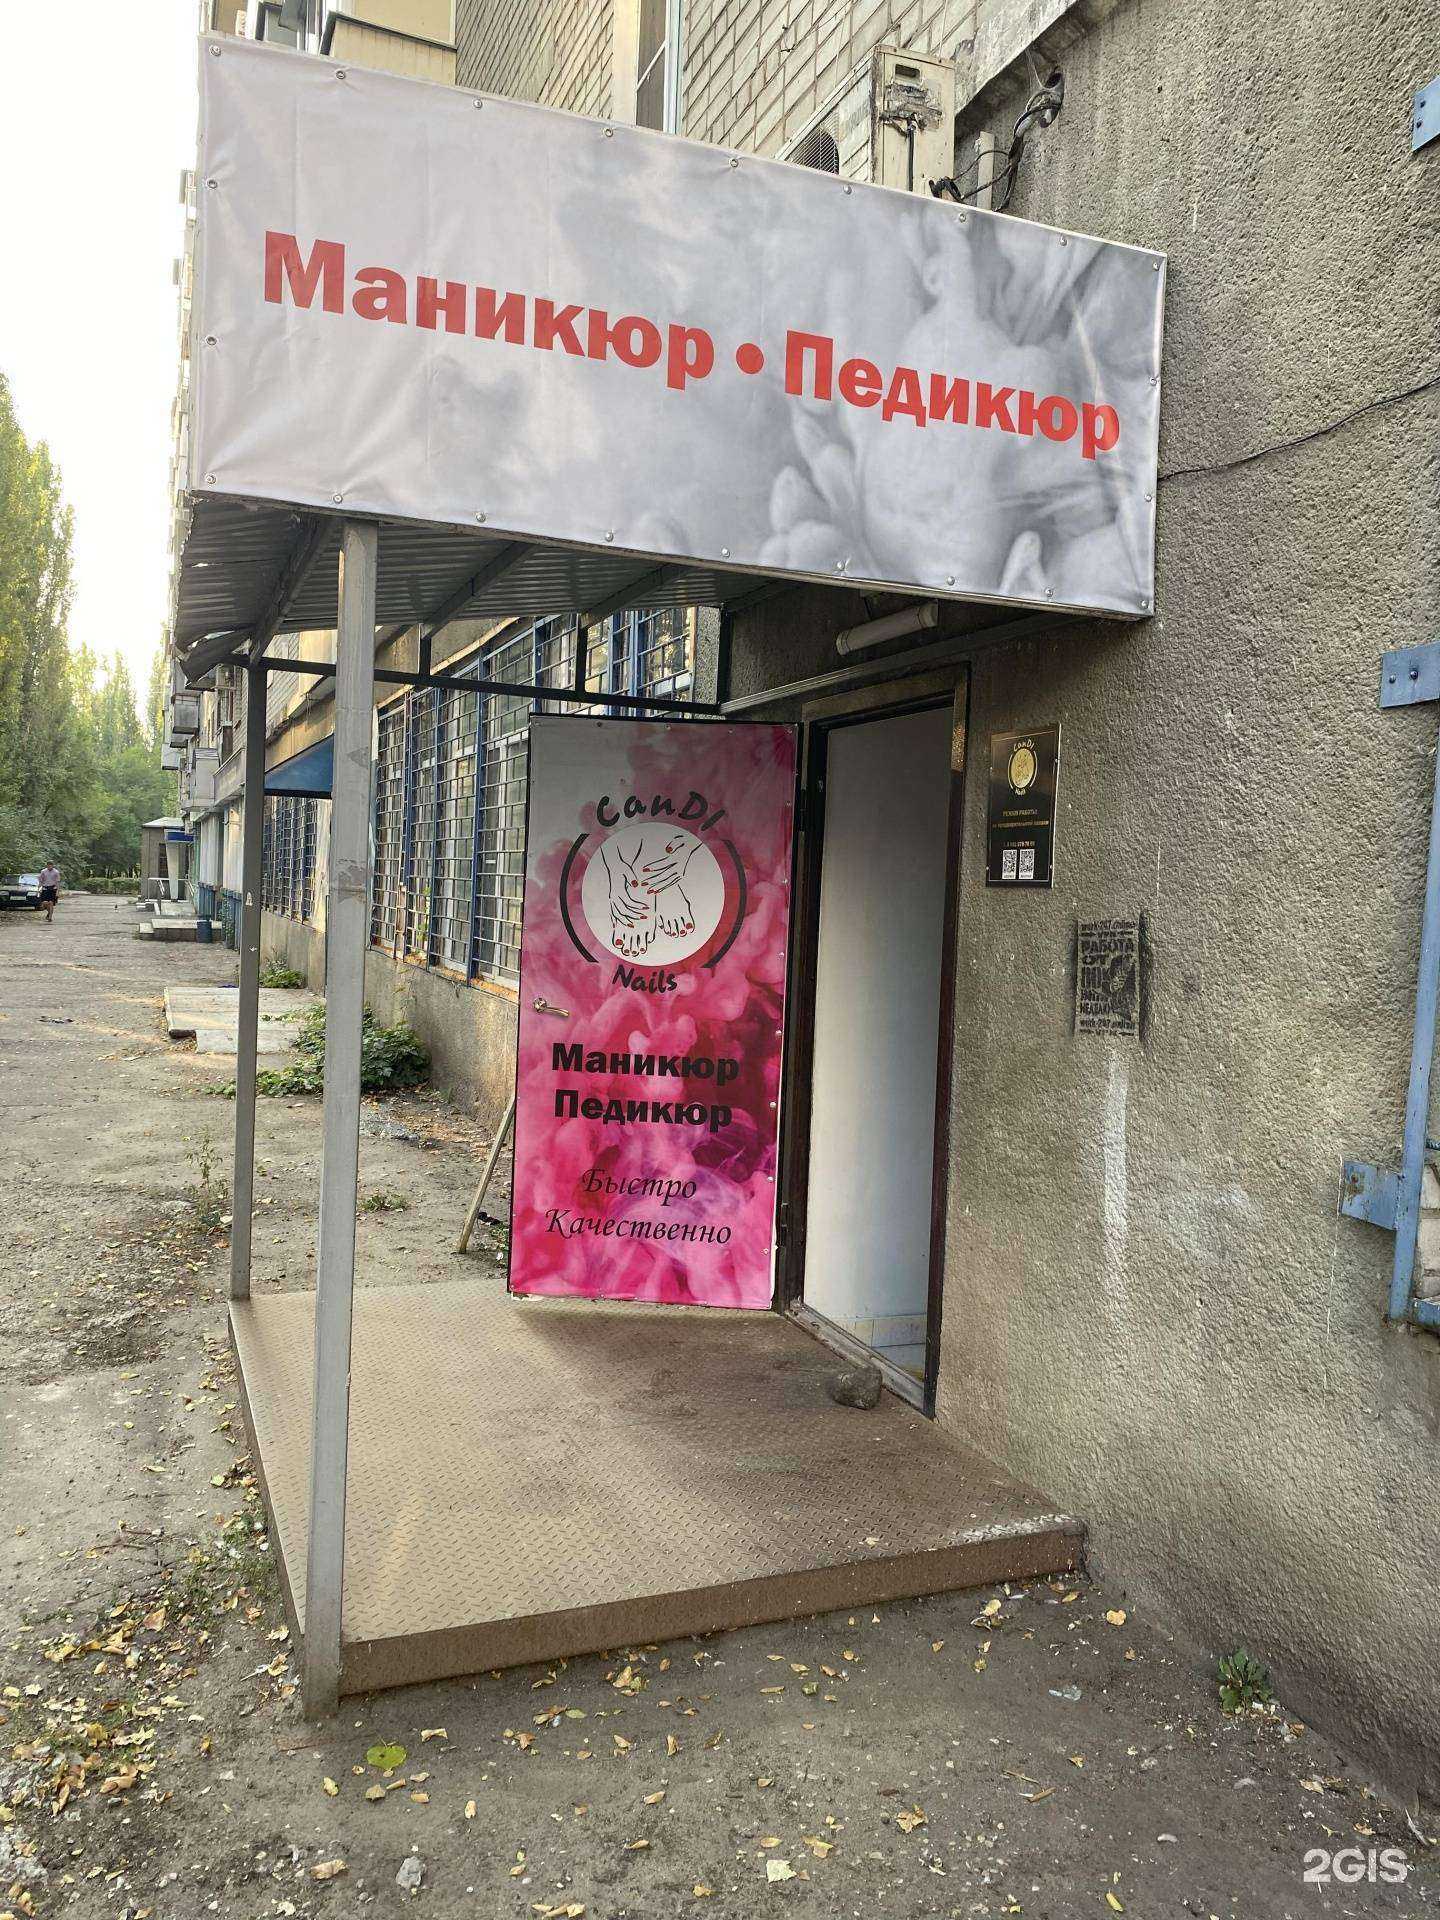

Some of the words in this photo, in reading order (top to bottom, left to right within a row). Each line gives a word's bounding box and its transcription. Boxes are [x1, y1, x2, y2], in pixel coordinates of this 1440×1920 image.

[266, 232, 714, 390] Маникюр
[785, 331, 1120, 460] Педикюр
[1081, 938, 1134, 954] РАБОТА
[612, 964, 678, 994] Nails
[552, 1042, 740, 1086] Маникюр
[555, 1089, 732, 1133] Педикюр
[582, 1168, 697, 1206] Быстро
[545, 1208, 732, 1244] Качественно
